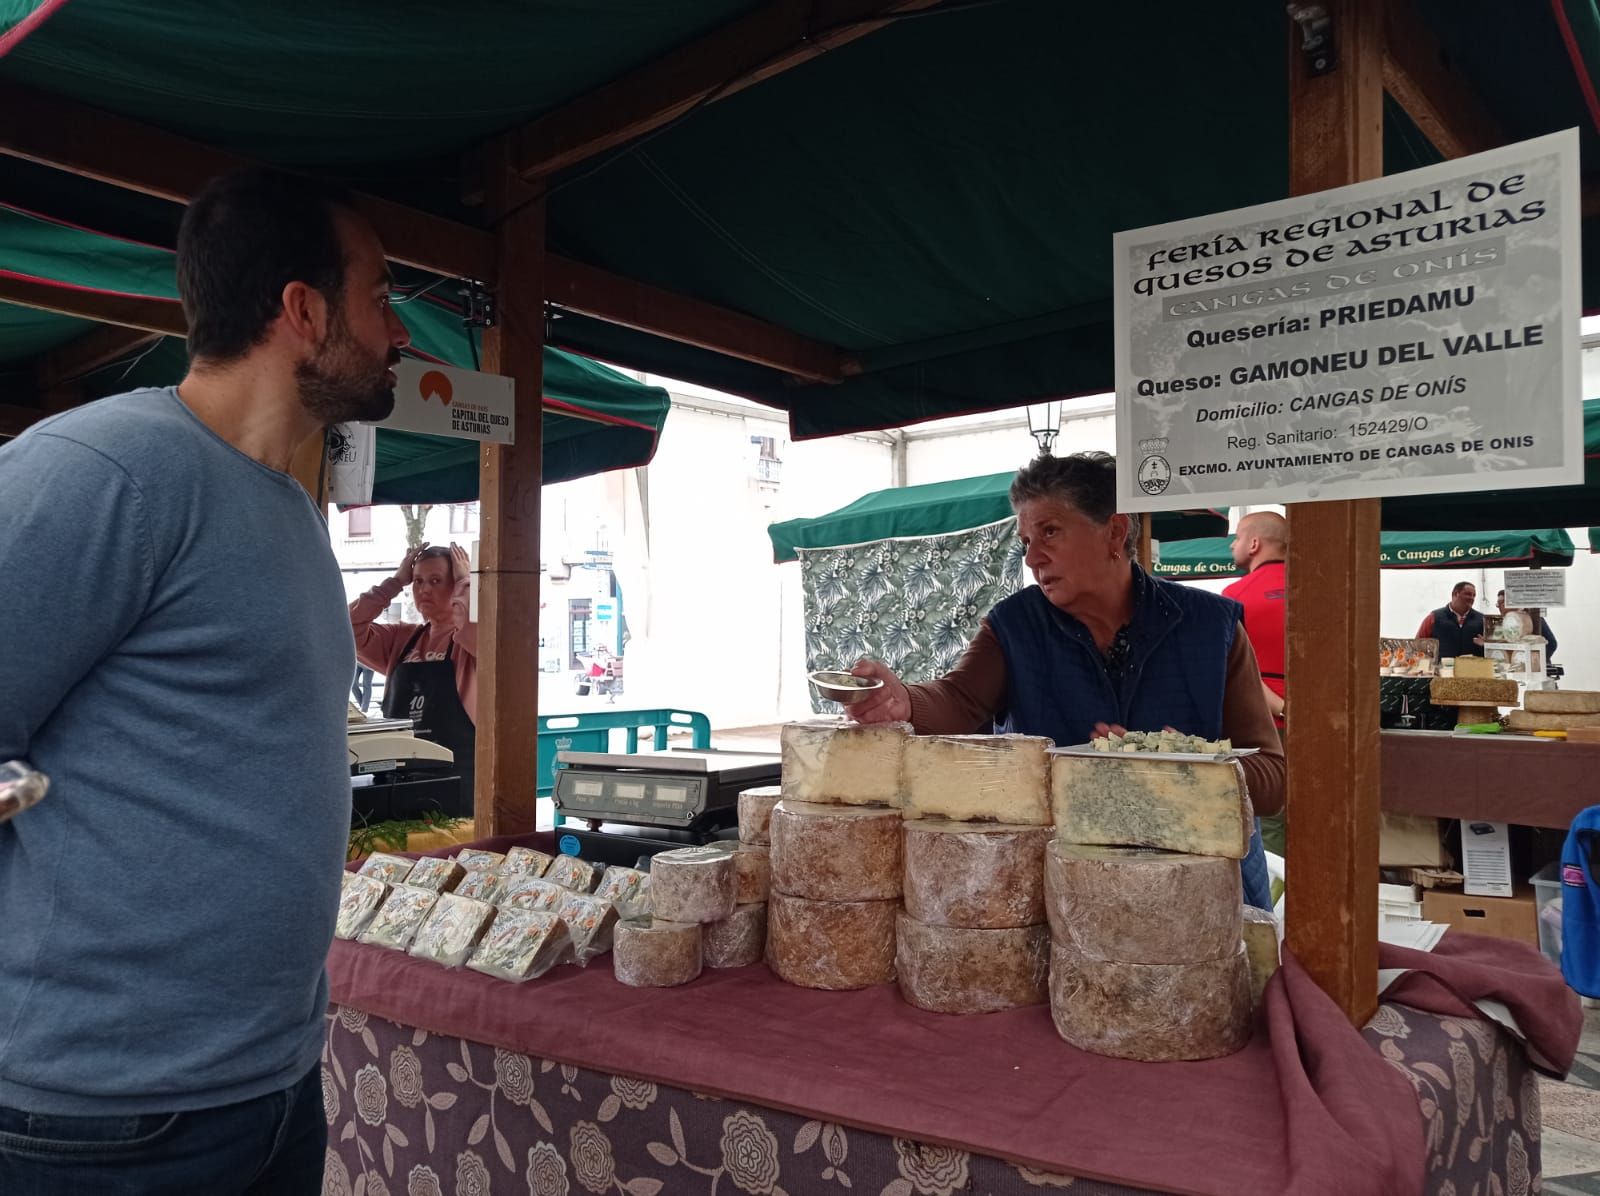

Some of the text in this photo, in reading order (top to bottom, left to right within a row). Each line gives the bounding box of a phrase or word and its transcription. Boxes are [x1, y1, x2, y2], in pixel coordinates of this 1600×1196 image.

[1257, 190, 1453, 248] REGIONAL
[1467, 174, 1525, 202] DE
[1133, 201, 1545, 296] QUESOS DE ASTURIAS
[1169, 282, 1311, 316] CANGAS
[1326, 271, 1377, 290] DE
[1187, 285, 1475, 348] Quesería: PRIEDAMU
[1137, 324, 1544, 397] Queso: GAMONEU DEL VALLE
[452, 409, 509, 426] CAPITAL DEL QUESO
[1196, 375, 1467, 423] Domicilio: CANGAS DE ONÍS
[452, 420, 491, 434] DE ASTURIAS
[1227, 436, 1261, 450] Reg.
[1266, 427, 1337, 446] Sanitario:
[1179, 435, 1534, 476] EXCMO. AYUNTAMIENTO DE CANGAS DE ONIS
[1153, 562, 1191, 575] Cangas
[1194, 562, 1208, 572] de
[1397, 549, 1445, 562] Cangas
[1449, 546, 1465, 558] de
[409, 695, 425, 710] 10
